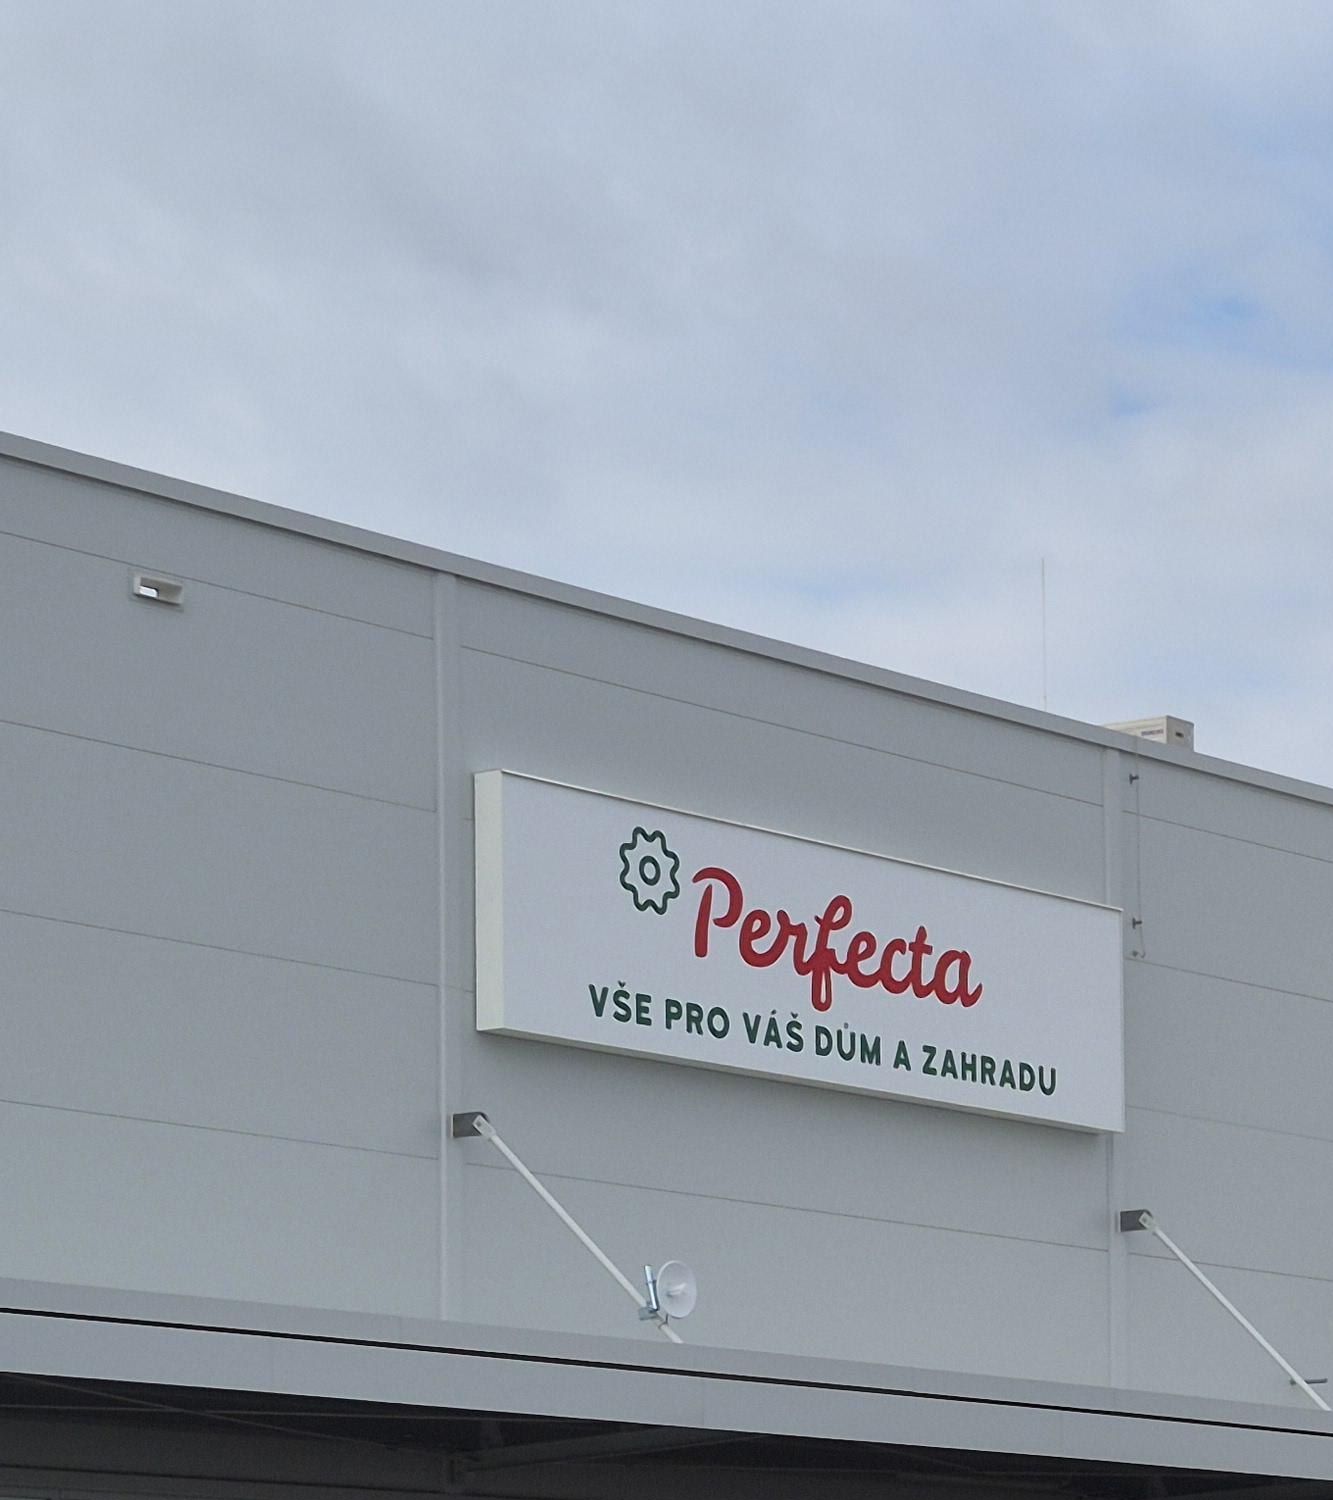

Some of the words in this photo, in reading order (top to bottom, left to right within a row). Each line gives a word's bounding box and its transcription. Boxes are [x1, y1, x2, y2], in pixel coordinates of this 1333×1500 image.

[692, 866, 983, 1012] Perfecta
[588, 980, 652, 1027] VŠE
[664, 998, 730, 1039] PRO
[743, 1009, 803, 1053] VÁŠ
[815, 1022, 881, 1066] DŮM
[893, 1039, 912, 1072] A
[921, 1045, 1057, 1096] ZAHRADU
